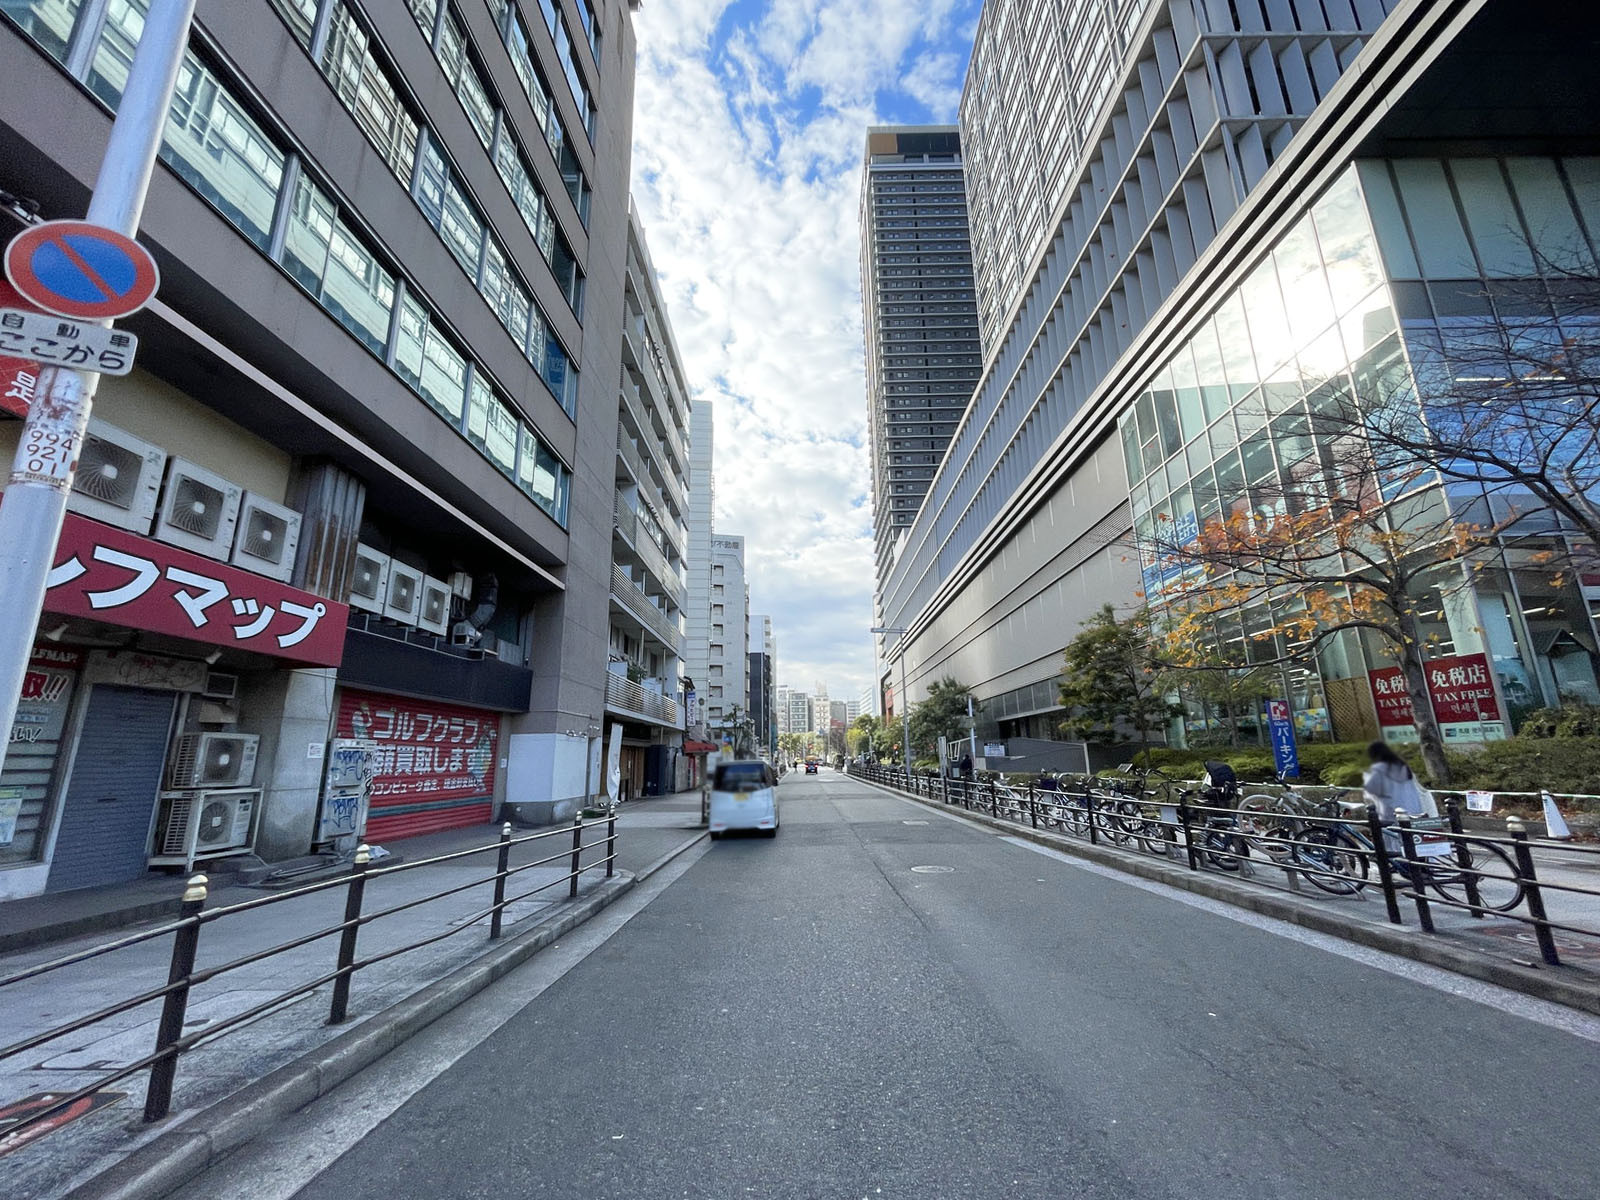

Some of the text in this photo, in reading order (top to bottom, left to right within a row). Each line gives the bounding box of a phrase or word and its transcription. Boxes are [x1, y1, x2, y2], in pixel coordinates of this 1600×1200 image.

[2, 313, 130, 347] 自動車
[0, 331, 126, 370] ここから
[31, 430, 73, 451] 994
[27, 444, 67, 463] 921
[28, 459, 57, 475] 01
[713, 540, 739, 549] 不動産
[1376, 675, 1408, 695] 免税
[1431, 664, 1486, 689] 免税店
[1379, 698, 1398, 708] TAX
[1434, 689, 1492, 703] TAX FREE
[373, 707, 479, 744] ゴルフクラブ
